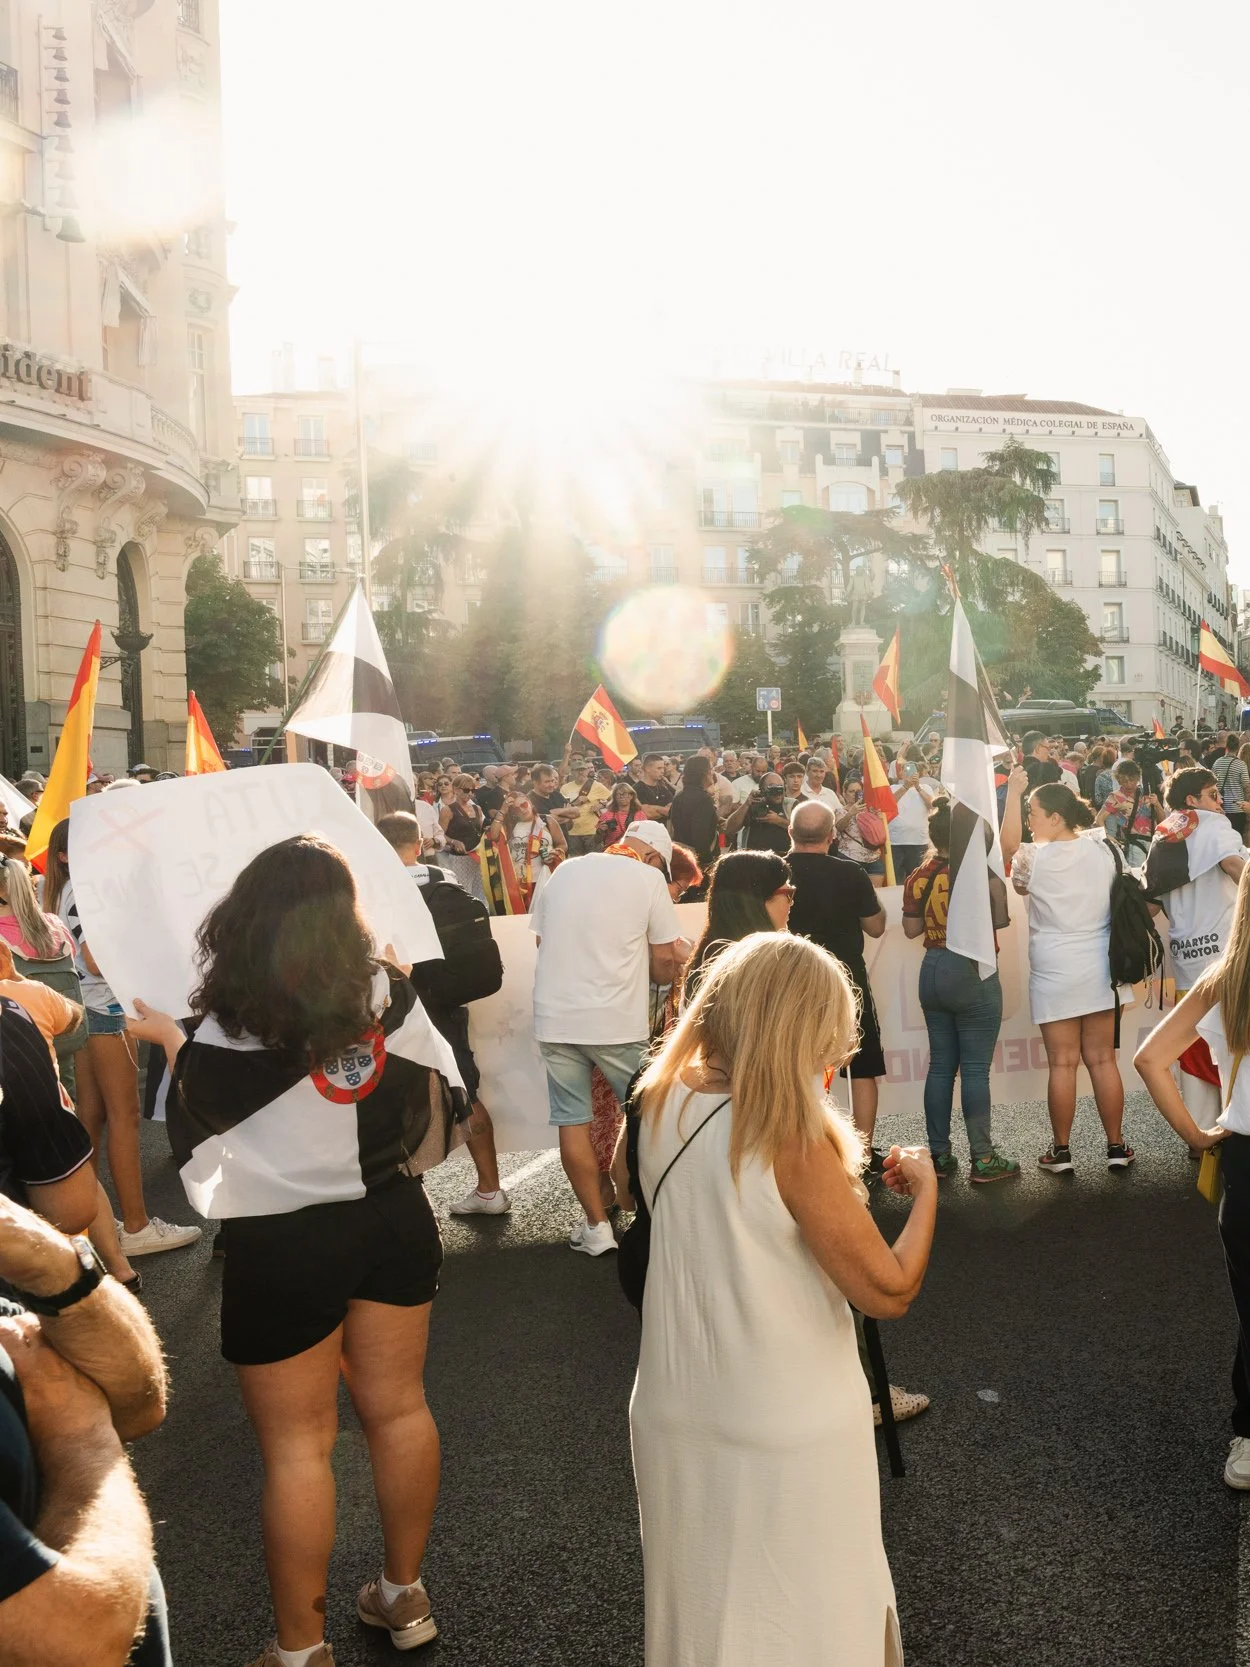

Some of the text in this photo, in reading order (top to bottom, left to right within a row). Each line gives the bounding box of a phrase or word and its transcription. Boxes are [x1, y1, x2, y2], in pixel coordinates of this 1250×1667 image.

[761, 344, 827, 370] VILLA
[839, 348, 894, 373] REAL
[0, 343, 93, 402] ident
[931, 413, 1134, 431] ORGANIZACIÓN MÉDICA COLEGIAL DE ESPAÑA
[927, 929, 947, 940] SPAI
[1182, 944, 1220, 960] MOTOR
